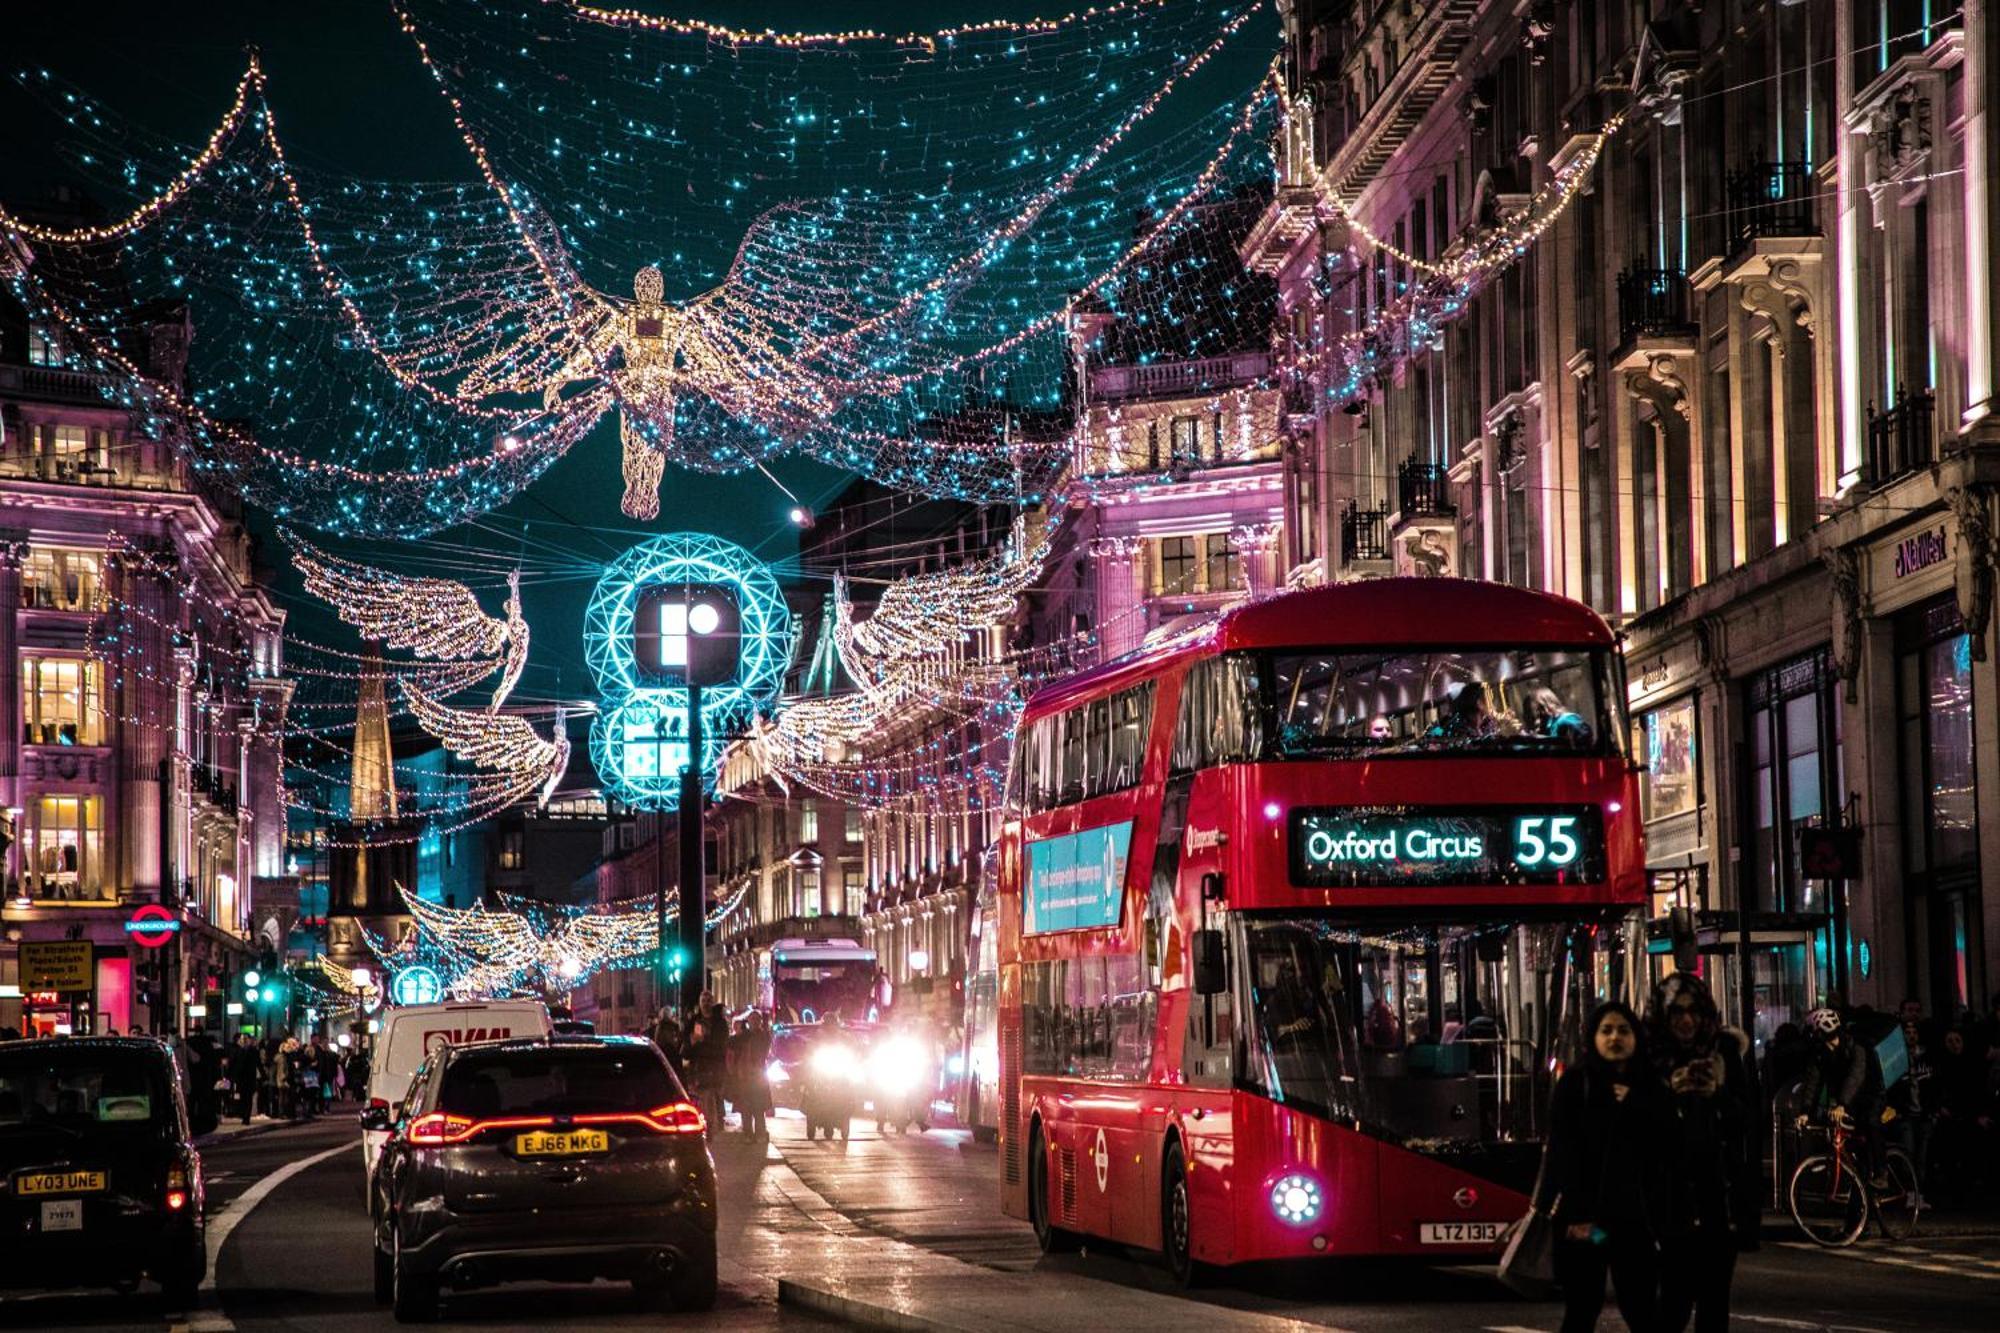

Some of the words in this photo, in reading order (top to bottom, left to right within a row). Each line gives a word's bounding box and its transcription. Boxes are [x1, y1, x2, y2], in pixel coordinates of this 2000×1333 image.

[1901, 525, 1946, 576] NatWest
[1308, 830, 1397, 860] Oxford
[1405, 829, 1482, 859] Circus
[1516, 817, 1578, 865] 55
[126, 921, 178, 930] UNDERGROUND
[45, 945, 85, 954] Stratford
[524, 1136, 565, 1152] EJ66
[570, 1135, 602, 1149] MKG
[23, 1176, 63, 1191] LY03
[68, 1173, 99, 1188] UNE
[1432, 1224, 1464, 1240] LTZ
[1467, 1224, 1496, 1239] 1313
